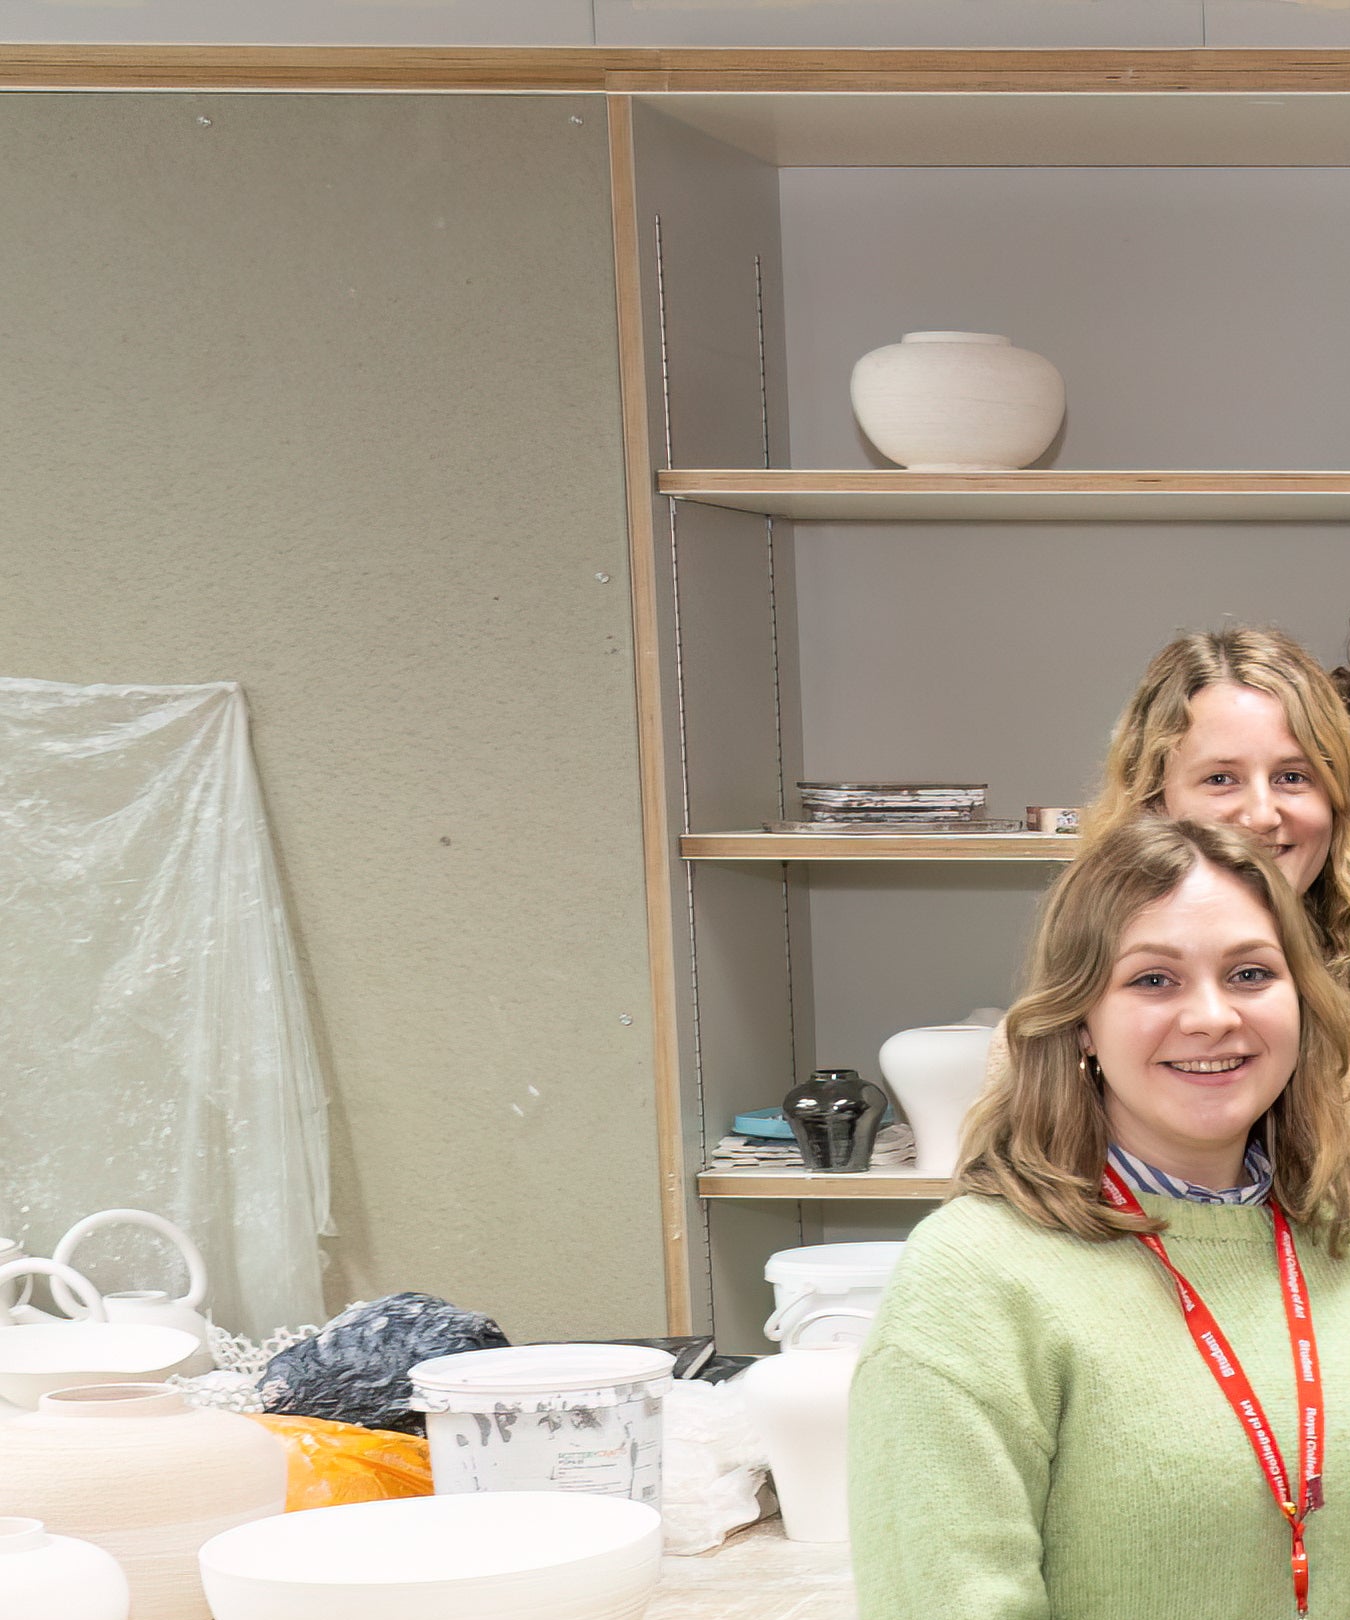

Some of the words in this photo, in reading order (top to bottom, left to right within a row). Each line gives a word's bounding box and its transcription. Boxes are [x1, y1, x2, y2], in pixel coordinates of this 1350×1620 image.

[1201, 1331, 1235, 1378] Student
[1298, 1339, 1315, 1382] Student
[1240, 1399, 1257, 1417] Art
[1304, 1407, 1318, 1440] Royal
[1257, 1430, 1280, 1476] College
